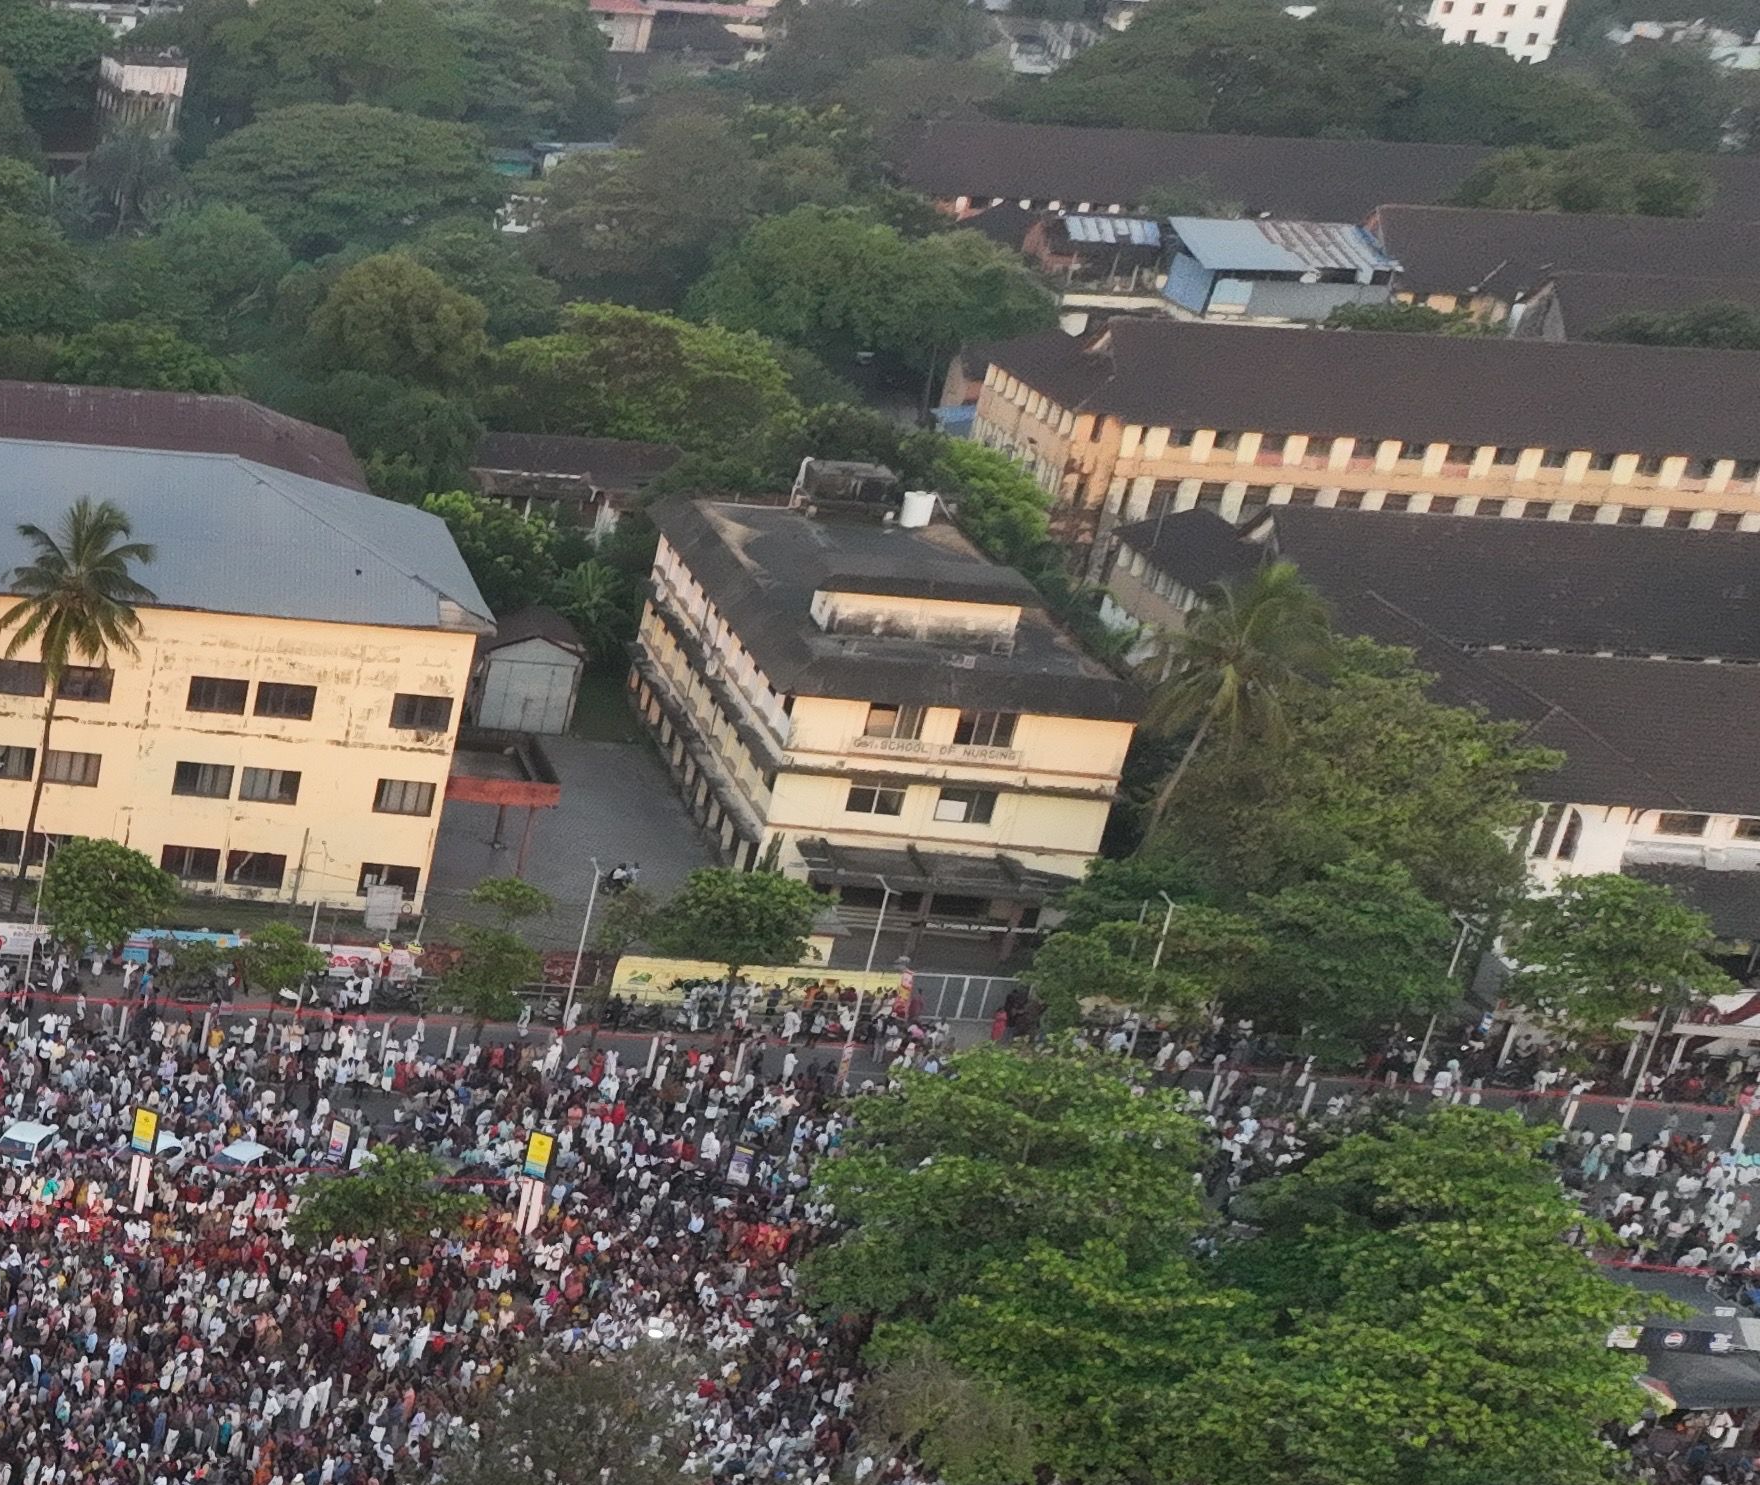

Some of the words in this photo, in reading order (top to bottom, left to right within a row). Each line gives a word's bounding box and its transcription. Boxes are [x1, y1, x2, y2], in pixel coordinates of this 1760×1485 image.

[880, 740, 929, 754] SCHOOL
[939, 746, 954, 756] OF
[963, 748, 1016, 761] NURSING
